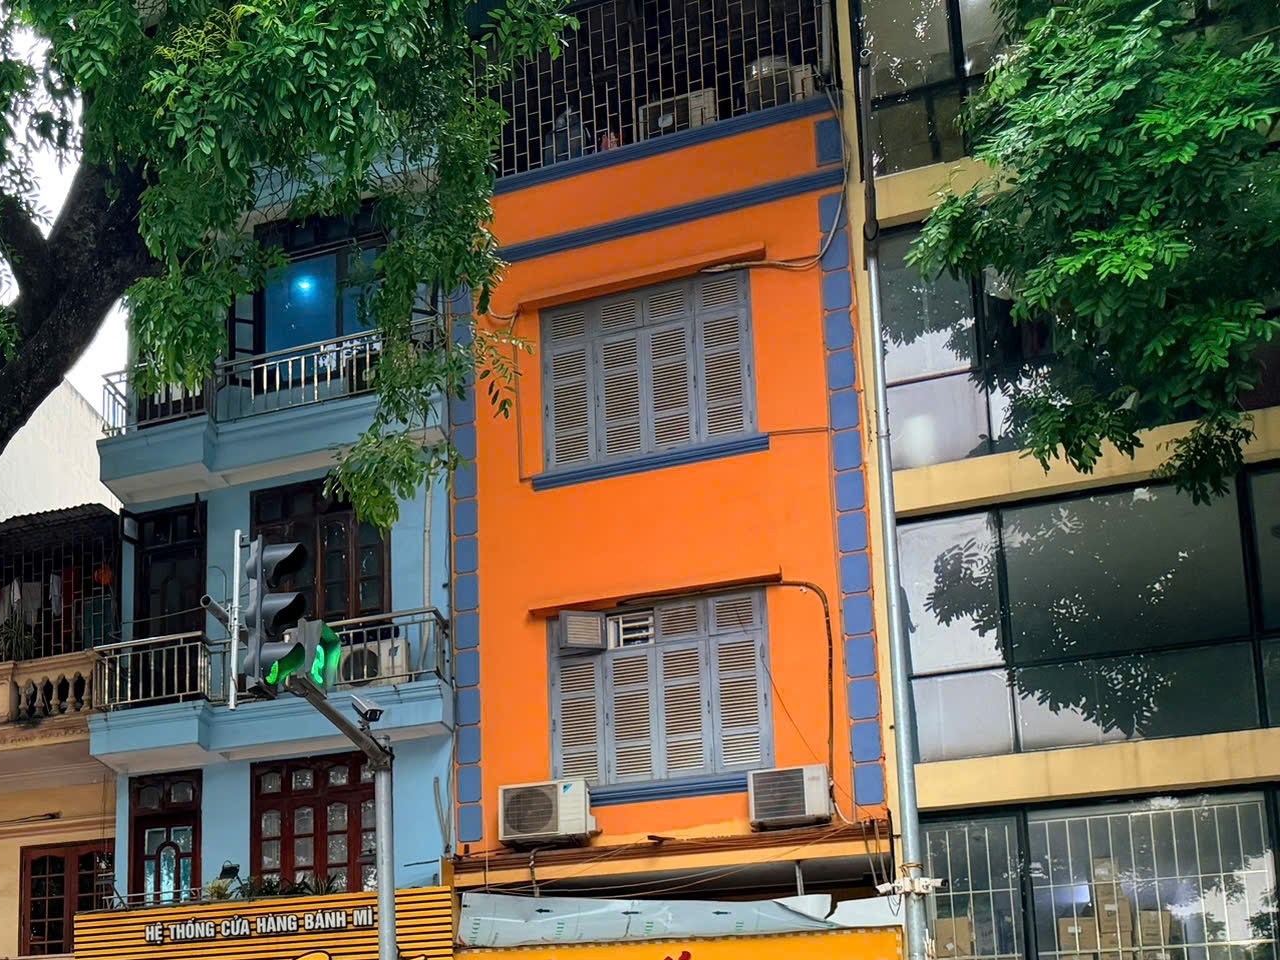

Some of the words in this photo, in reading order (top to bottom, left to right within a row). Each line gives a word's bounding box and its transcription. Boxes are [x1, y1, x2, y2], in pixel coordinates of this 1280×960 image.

[145, 923, 164, 944] HỆ
[168, 917, 216, 941] THỐNG
[220, 914, 251, 937] CỬA
[256, 913, 298, 934] HÀNG
[304, 909, 347, 931] BÁNH
[352, 905, 374, 928] MÌ
